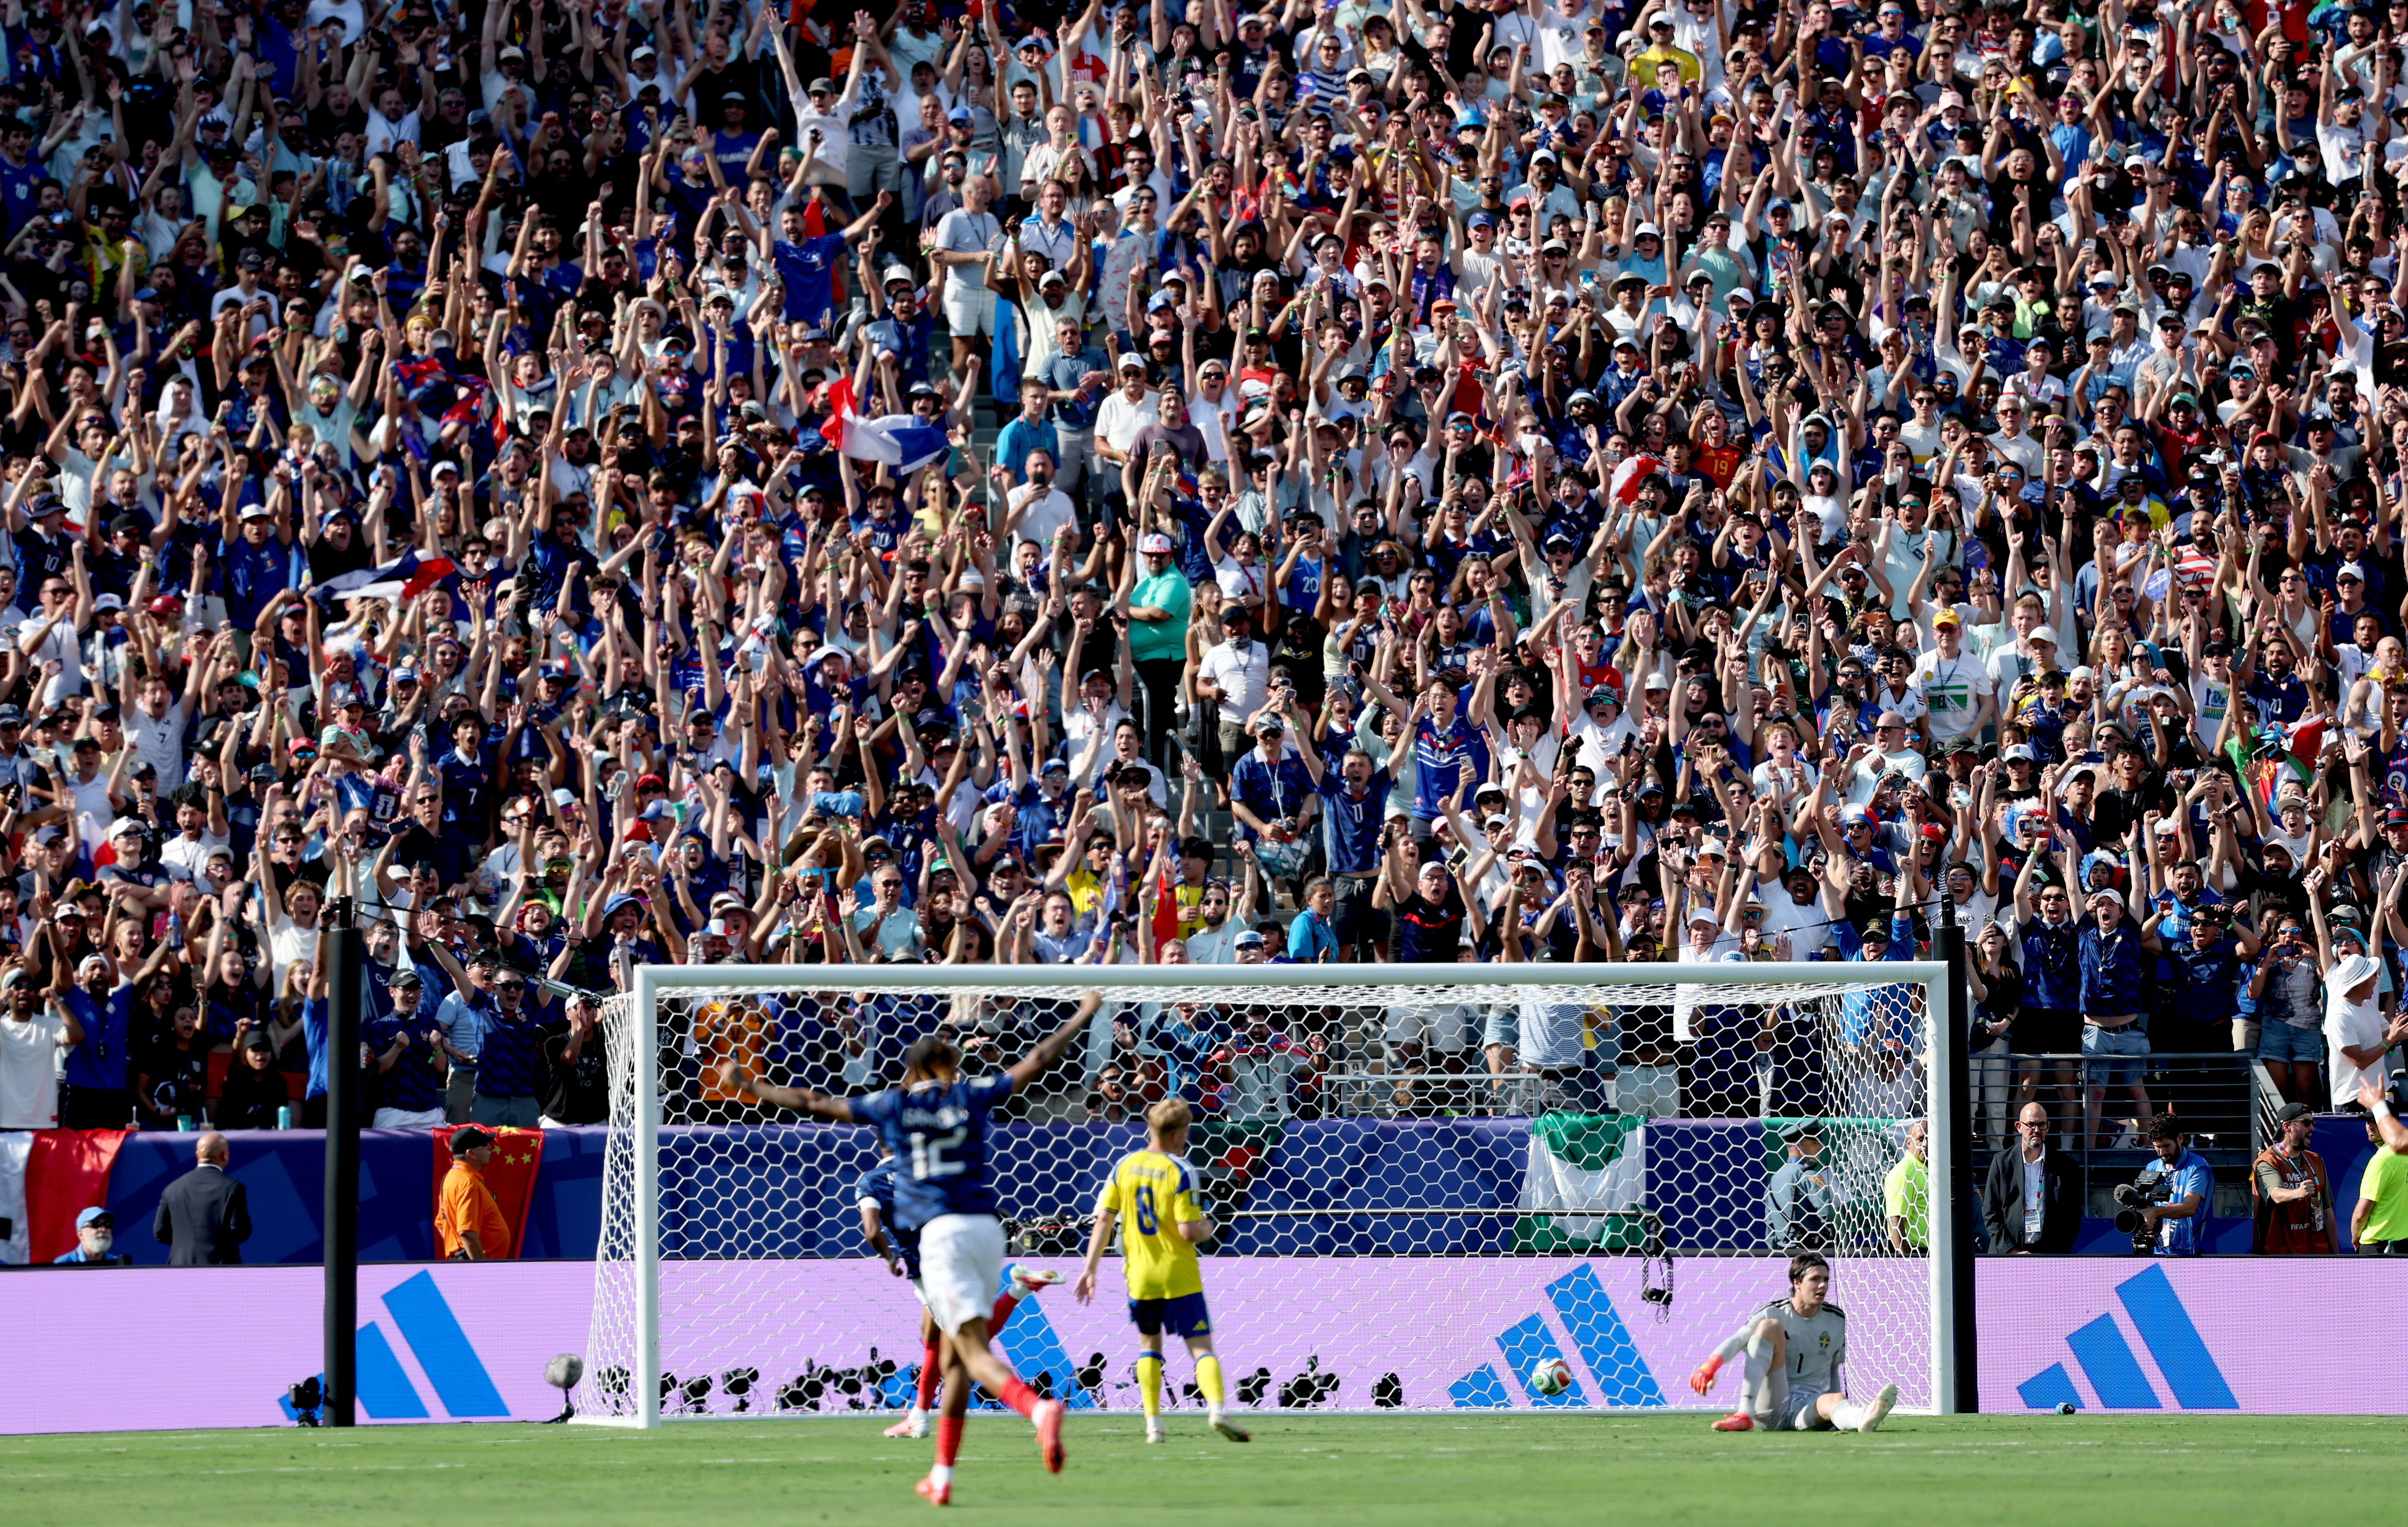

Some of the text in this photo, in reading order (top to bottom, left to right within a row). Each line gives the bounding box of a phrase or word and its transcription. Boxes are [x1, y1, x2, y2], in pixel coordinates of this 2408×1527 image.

[14, 182, 28, 200] 10
[1714, 459, 1728, 475] 19
[875, 531, 891, 547] 10
[43, 554, 59, 572] 10
[1301, 576, 1319, 593] 20
[1352, 644, 1366, 661] 10
[159, 733, 166, 744] 7
[1347, 736, 1363, 749] 10
[469, 787, 477, 806] 7
[1352, 804, 1363, 823] 11
[1003, 858, 1012, 867] NY
[910, 1126, 968, 1181] 12
[1796, 1352, 1804, 1374] 1
